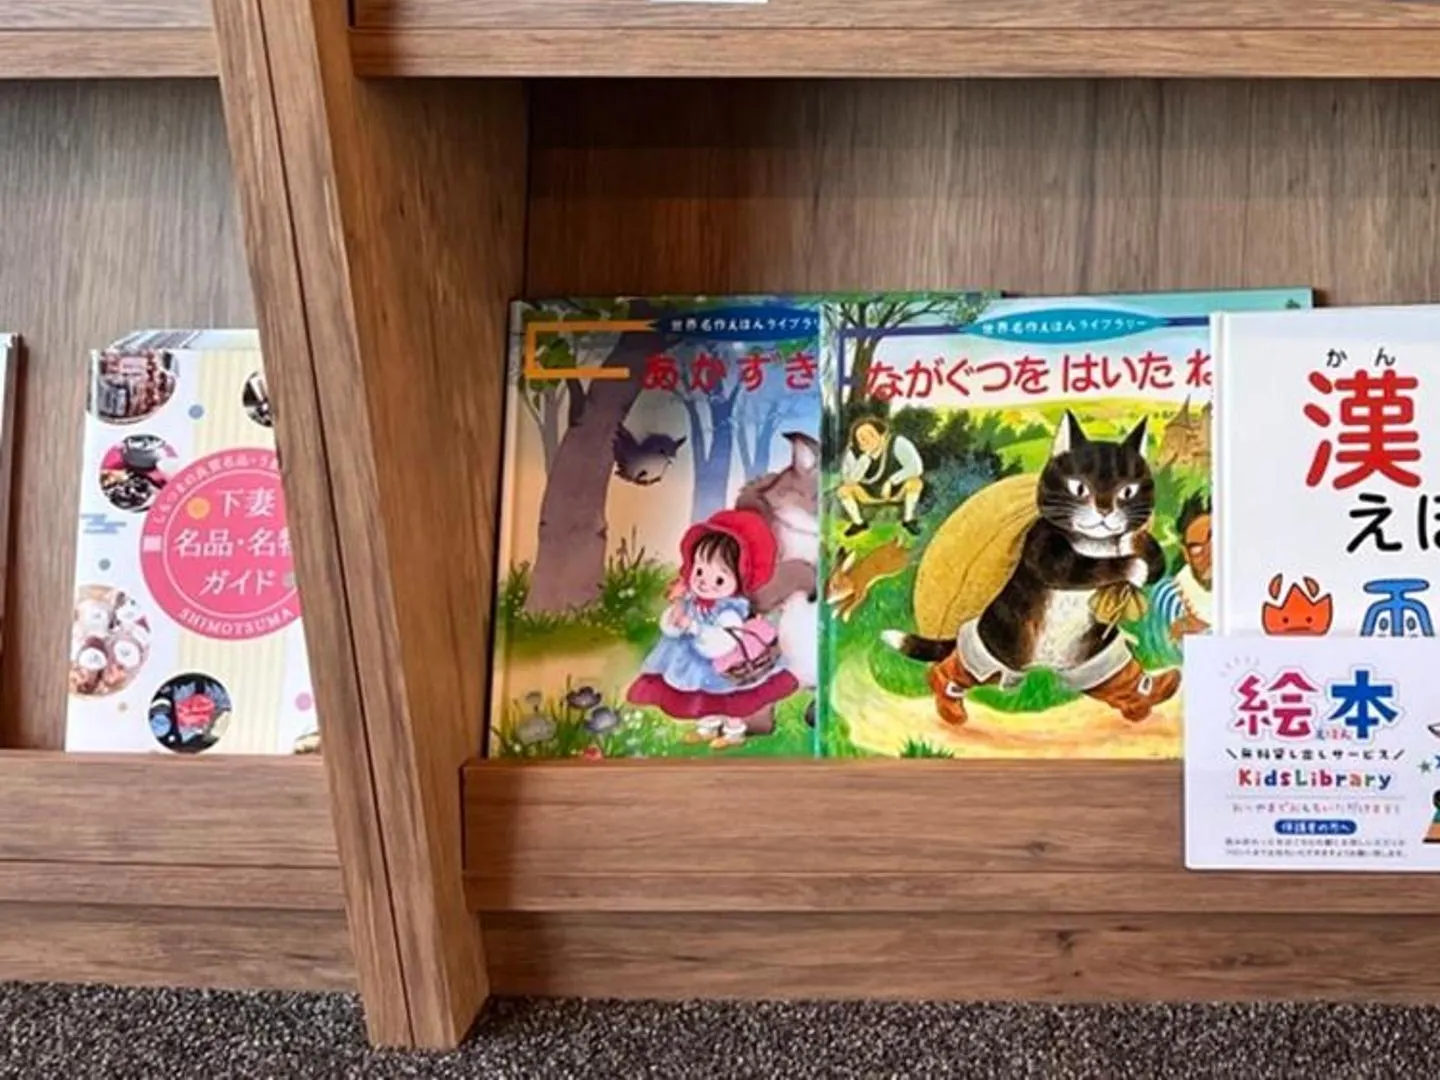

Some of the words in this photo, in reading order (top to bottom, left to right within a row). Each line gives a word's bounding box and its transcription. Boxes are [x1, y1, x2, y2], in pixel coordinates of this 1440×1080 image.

[217, 487, 276, 517] 下妻
[198, 569, 276, 596] ガイド
[179, 607, 294, 635] SHIMOTSUMA
[1234, 670, 1398, 739] 絵本
[1238, 769, 1391, 790] KidsLibrary
